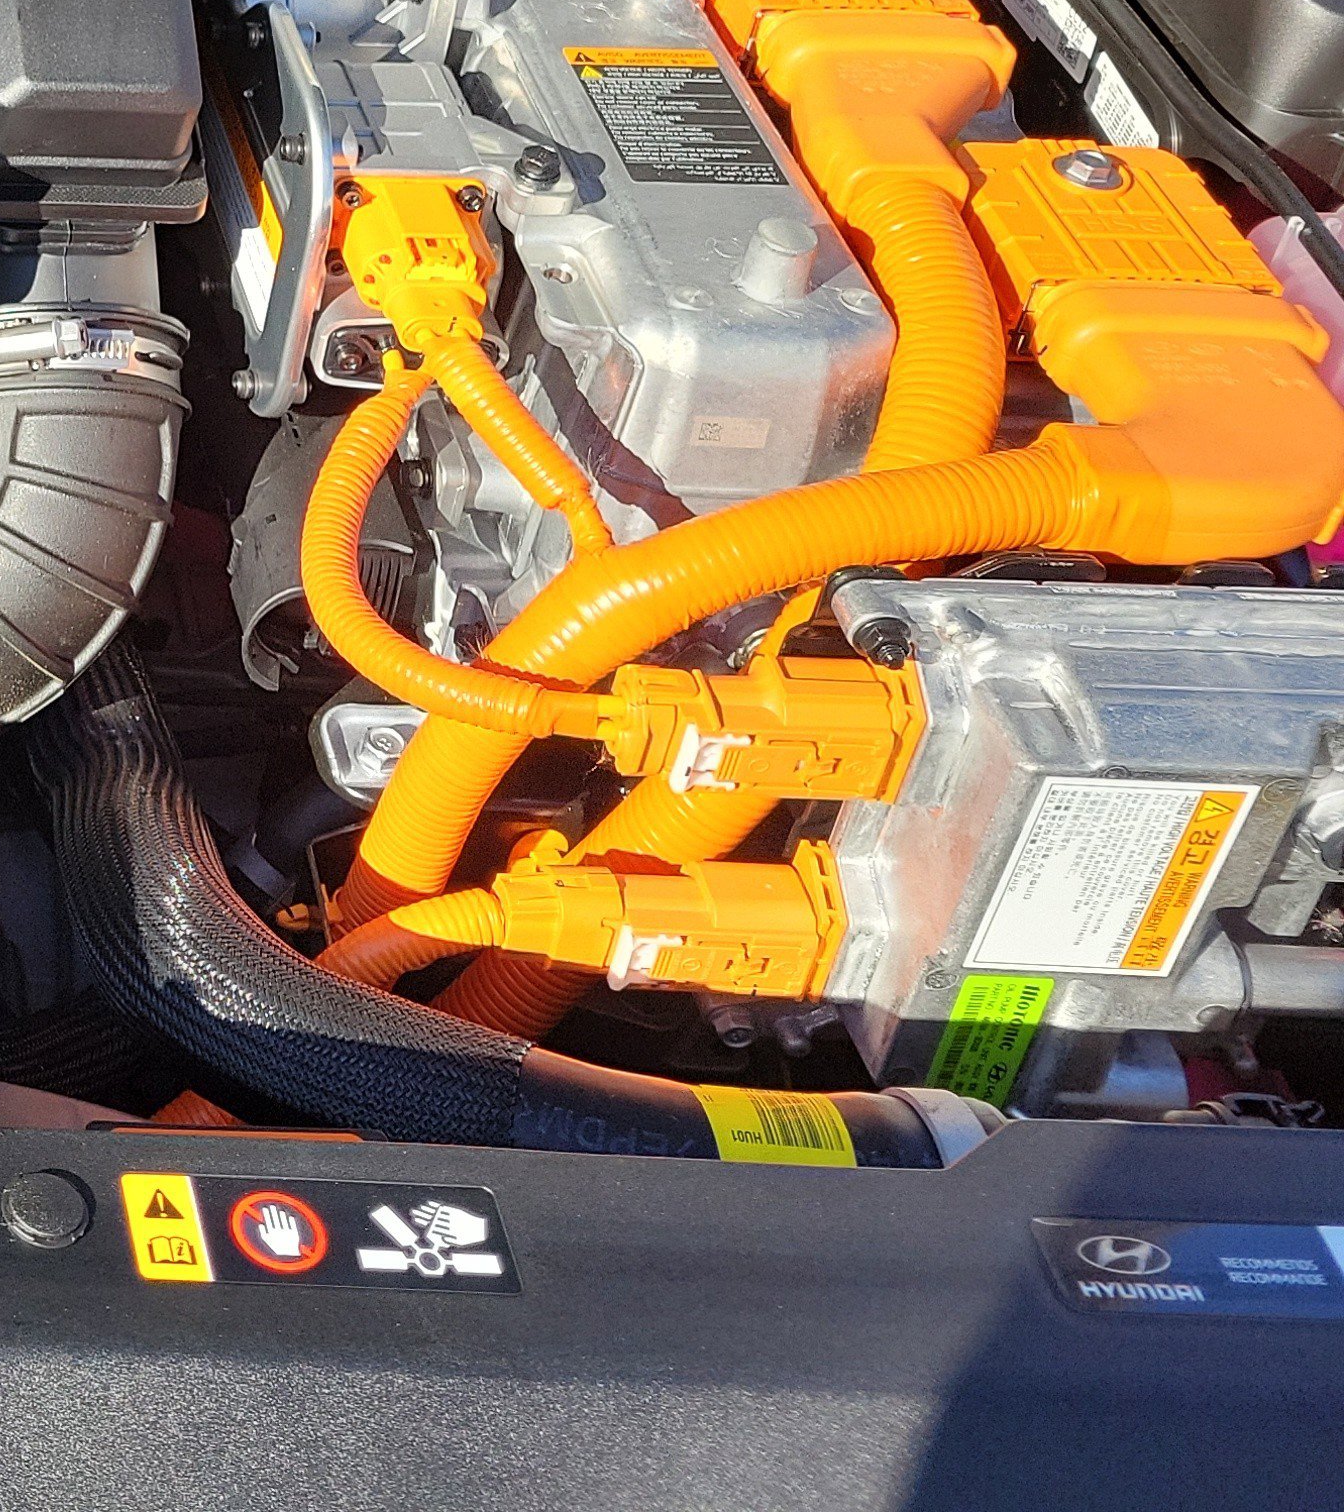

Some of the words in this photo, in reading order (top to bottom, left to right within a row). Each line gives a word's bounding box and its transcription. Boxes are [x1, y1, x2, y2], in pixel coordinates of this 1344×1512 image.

[1163, 821, 1186, 840] HIGH
[1146, 841, 1176, 875] VOLTAGE
[1176, 828, 1222, 866] 경고
[1133, 880, 1158, 904] HAUTE
[1141, 870, 1186, 932] AVERTISSEMENT
[1171, 871, 1203, 908] WARNING
[1118, 906, 1146, 936] TENSION
[730, 1128, 763, 1145] HU01
[1077, 1280, 1206, 1302] HYUNDAI
